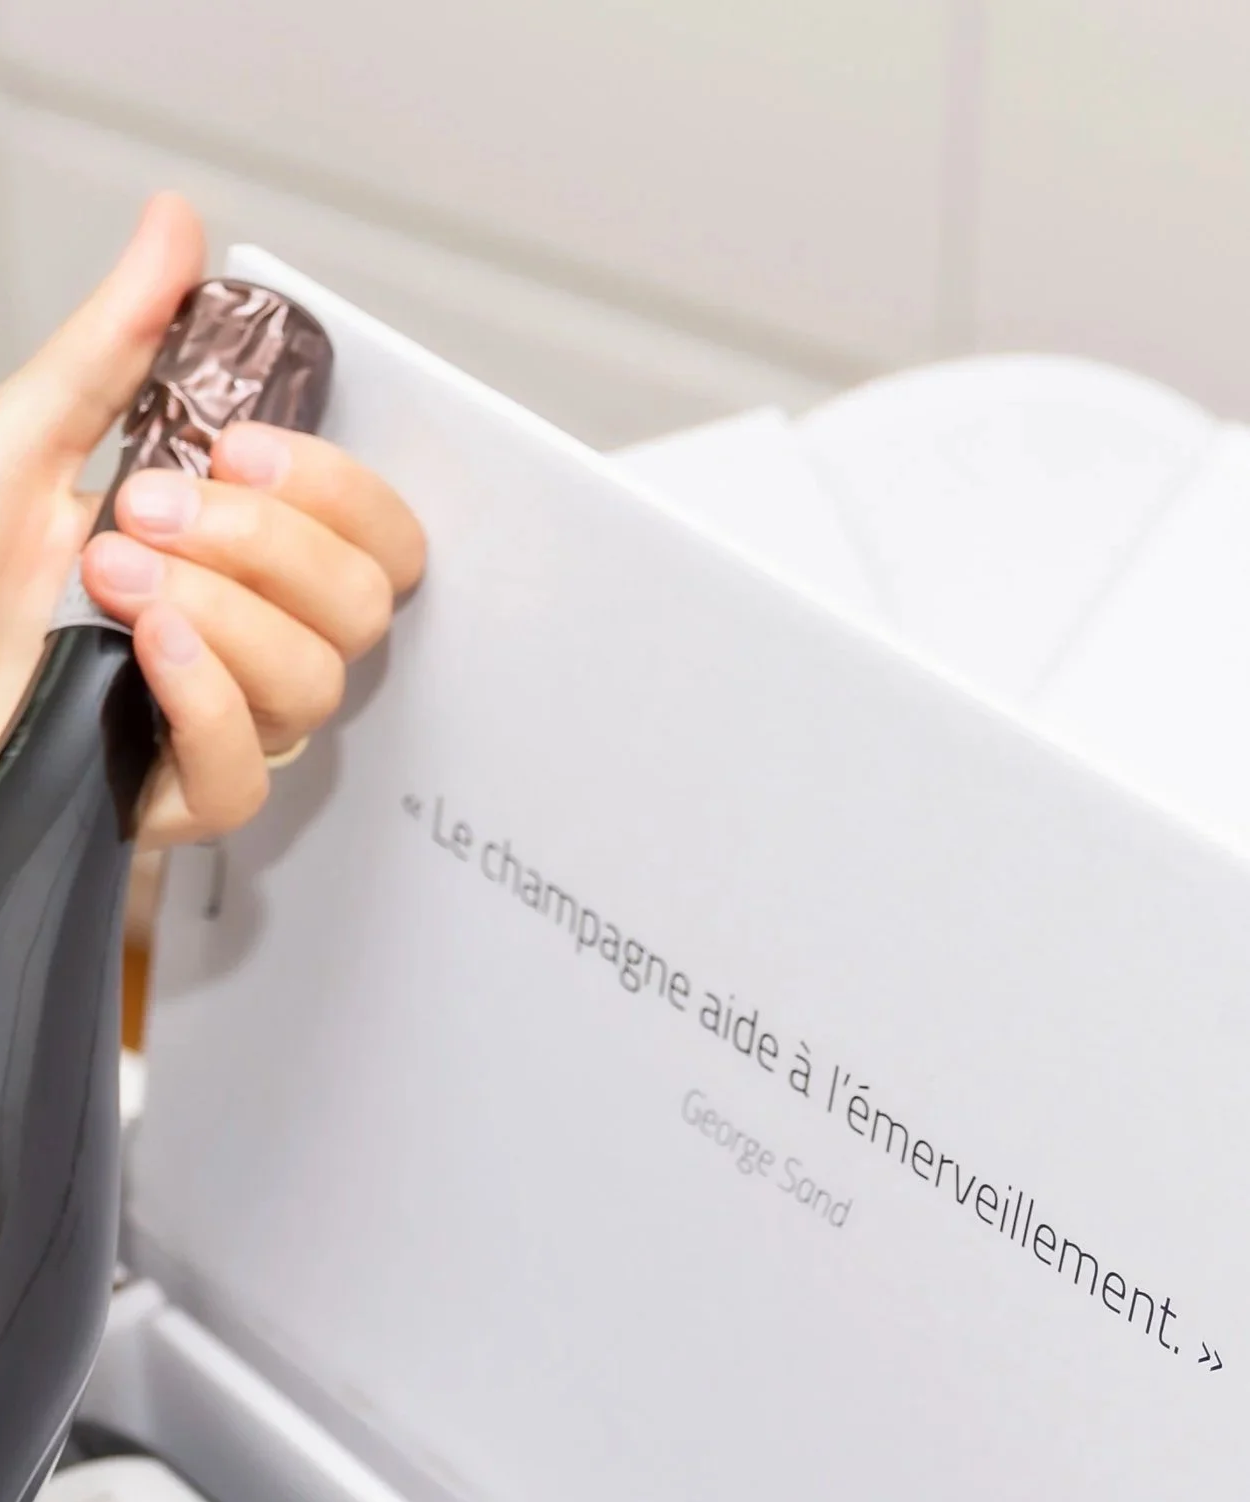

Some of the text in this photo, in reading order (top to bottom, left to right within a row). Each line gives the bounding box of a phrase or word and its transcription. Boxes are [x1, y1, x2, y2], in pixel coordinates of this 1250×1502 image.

[431, 796, 474, 862] Le
[480, 839, 692, 1012] champagne
[699, 992, 779, 1073] aide
[788, 1040, 812, 1098] à
[827, 1064, 1180, 1355] l'émerveillement.
[680, 1088, 854, 1229] George Sand
